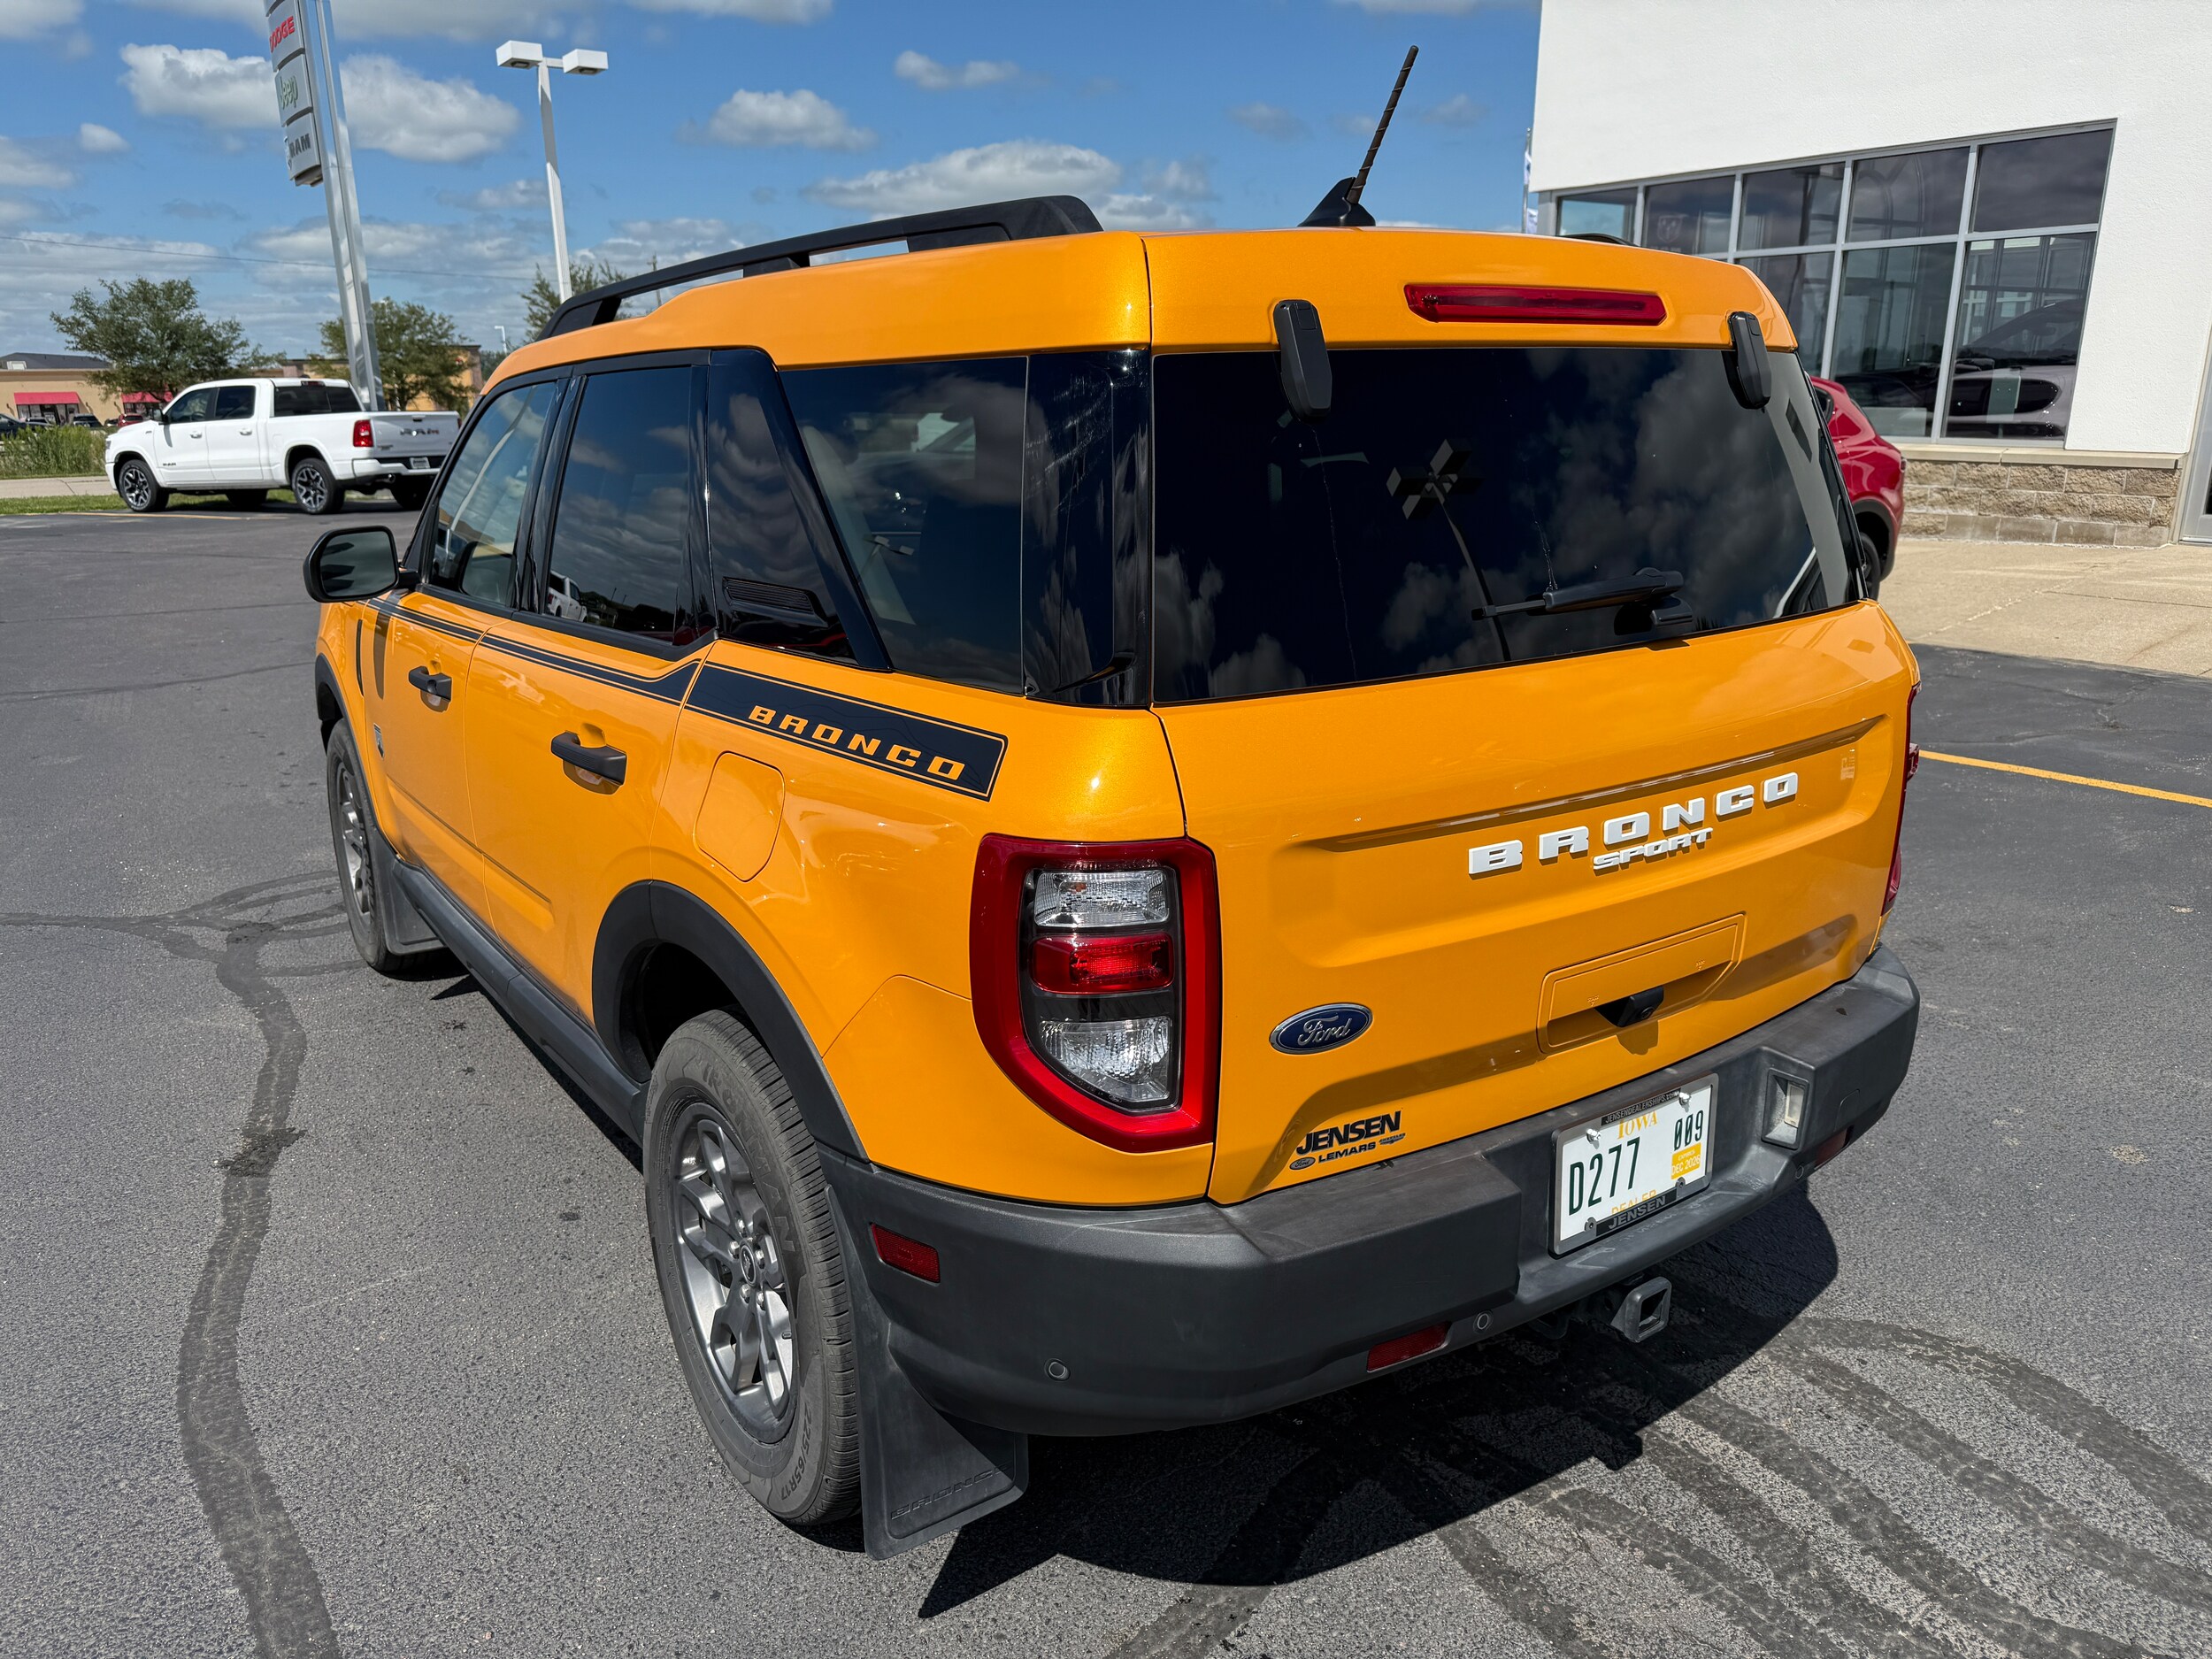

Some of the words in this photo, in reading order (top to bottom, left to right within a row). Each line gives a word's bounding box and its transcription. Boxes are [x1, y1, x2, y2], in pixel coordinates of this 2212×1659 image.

[280, 74, 299, 111] Jeep
[288, 133, 311, 158] RAM
[749, 705, 965, 780] BRONCO
[1468, 772, 1799, 875] BRONCO
[1593, 827, 1714, 871] SPORT
[1297, 1012, 1353, 1046] Ford
[1296, 1110, 1402, 1156] JENSEN
[1674, 1110, 1704, 1151] 009
[1318, 1141, 1377, 1164] LEMARS
[1569, 1137, 1640, 1216] D277
[1609, 1195, 1666, 1230] JENSEN
[780, 1402, 812, 1501] 225/65R17
